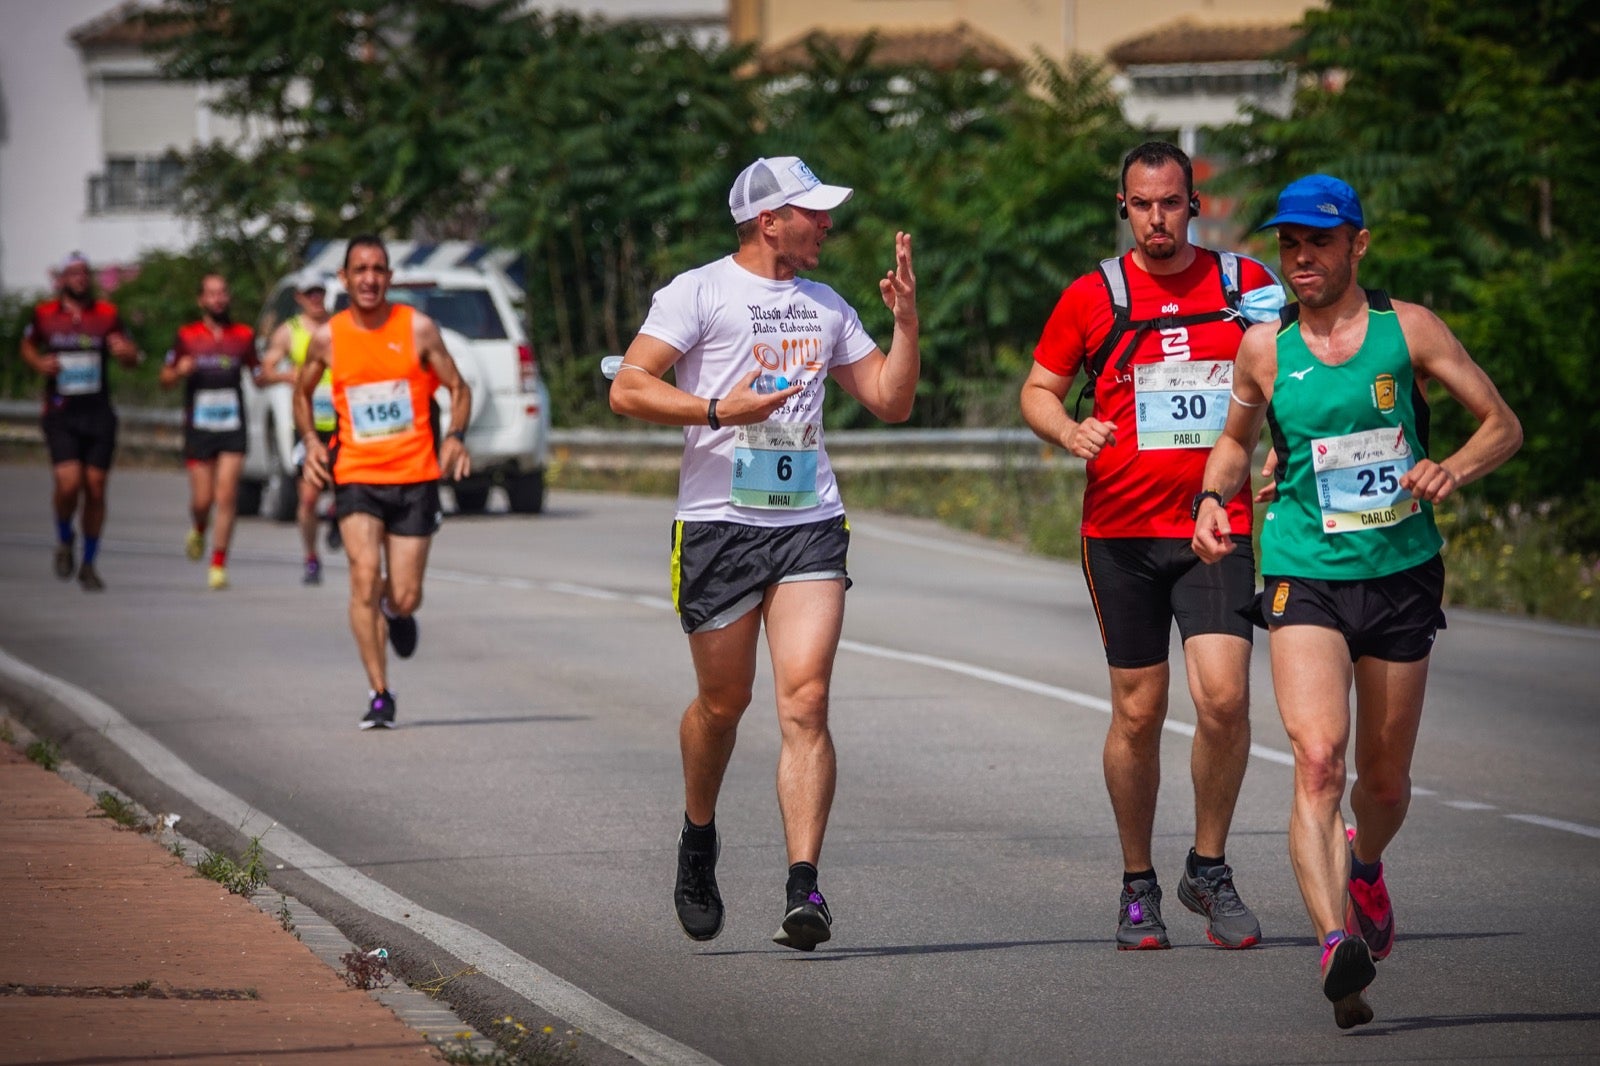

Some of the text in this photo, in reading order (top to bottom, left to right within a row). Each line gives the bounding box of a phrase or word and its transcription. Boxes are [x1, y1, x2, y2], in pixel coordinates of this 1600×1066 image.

[1161, 302, 1179, 315] edp
[752, 322, 822, 336] Platos Elaborados
[365, 402, 401, 422] 156
[1139, 402, 1147, 422] SENIOR
[1171, 394, 1207, 420] 30
[1174, 433, 1201, 445] PABLO
[735, 458, 744, 478] SENIOR
[777, 455, 793, 481] 6
[1356, 465, 1399, 497] 25
[768, 494, 791, 506] MIHAI
[1361, 509, 1397, 525] CARLOS
